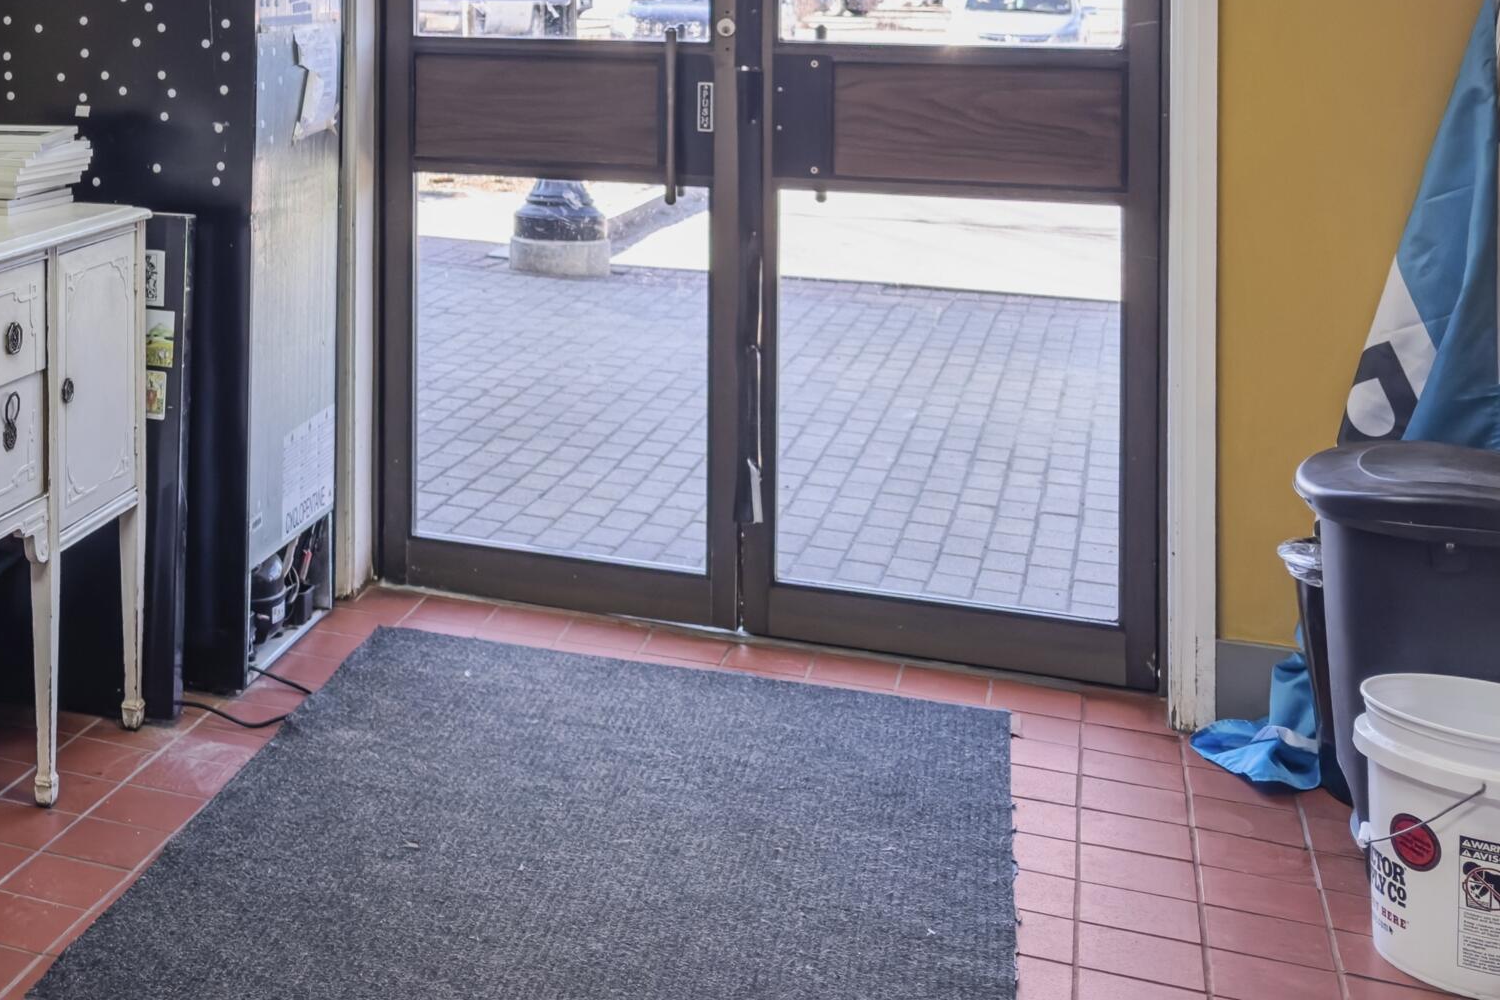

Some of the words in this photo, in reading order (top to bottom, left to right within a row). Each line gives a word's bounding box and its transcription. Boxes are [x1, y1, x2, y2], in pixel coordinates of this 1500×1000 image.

[701, 90, 709, 125] PUSH
[285, 485, 327, 535] CYCLOPENTANE
[1381, 905, 1407, 930] HERE
